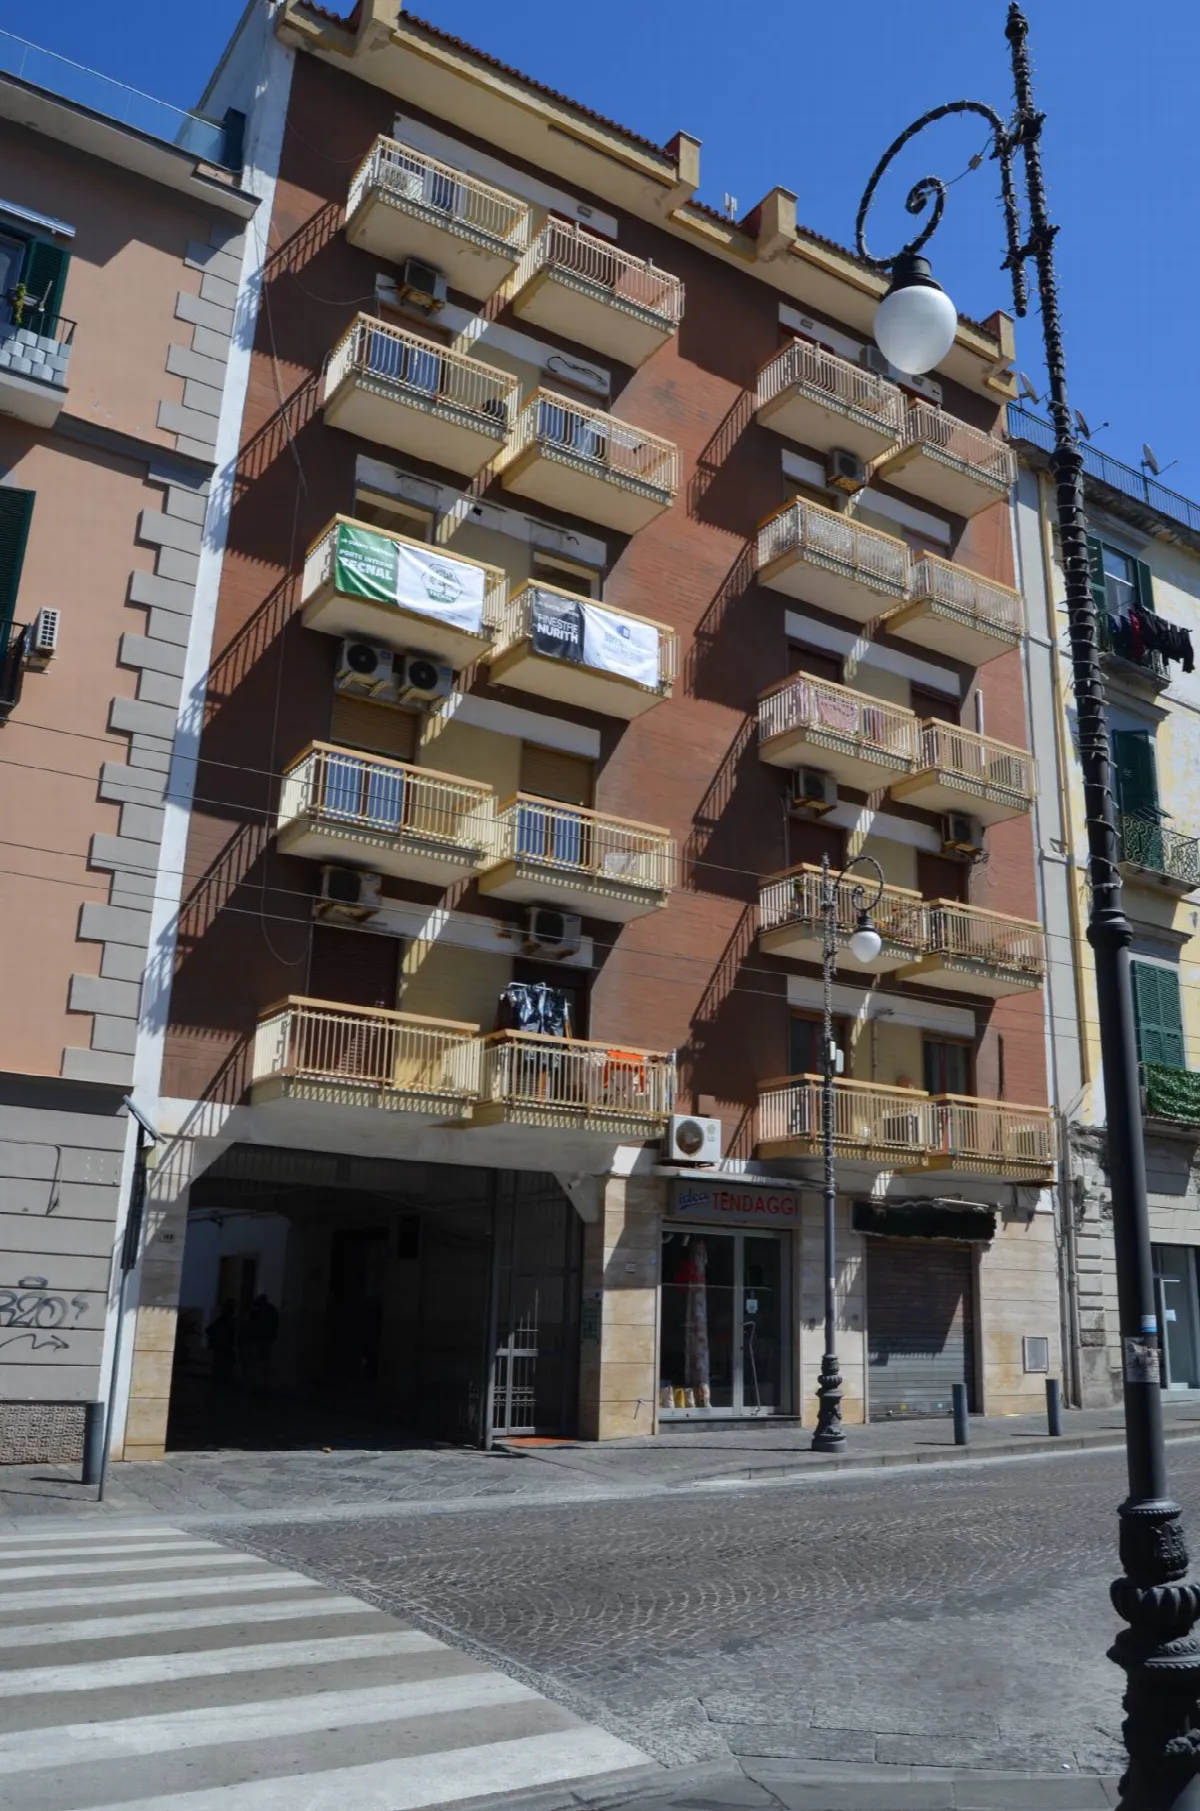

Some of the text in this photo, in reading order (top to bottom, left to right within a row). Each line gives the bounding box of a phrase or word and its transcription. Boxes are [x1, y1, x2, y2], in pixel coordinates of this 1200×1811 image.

[537, 613, 579, 634] FINESTRE
[537, 622, 578, 644] NURITH
[679, 1187, 799, 1215] idea TENDAGGI
